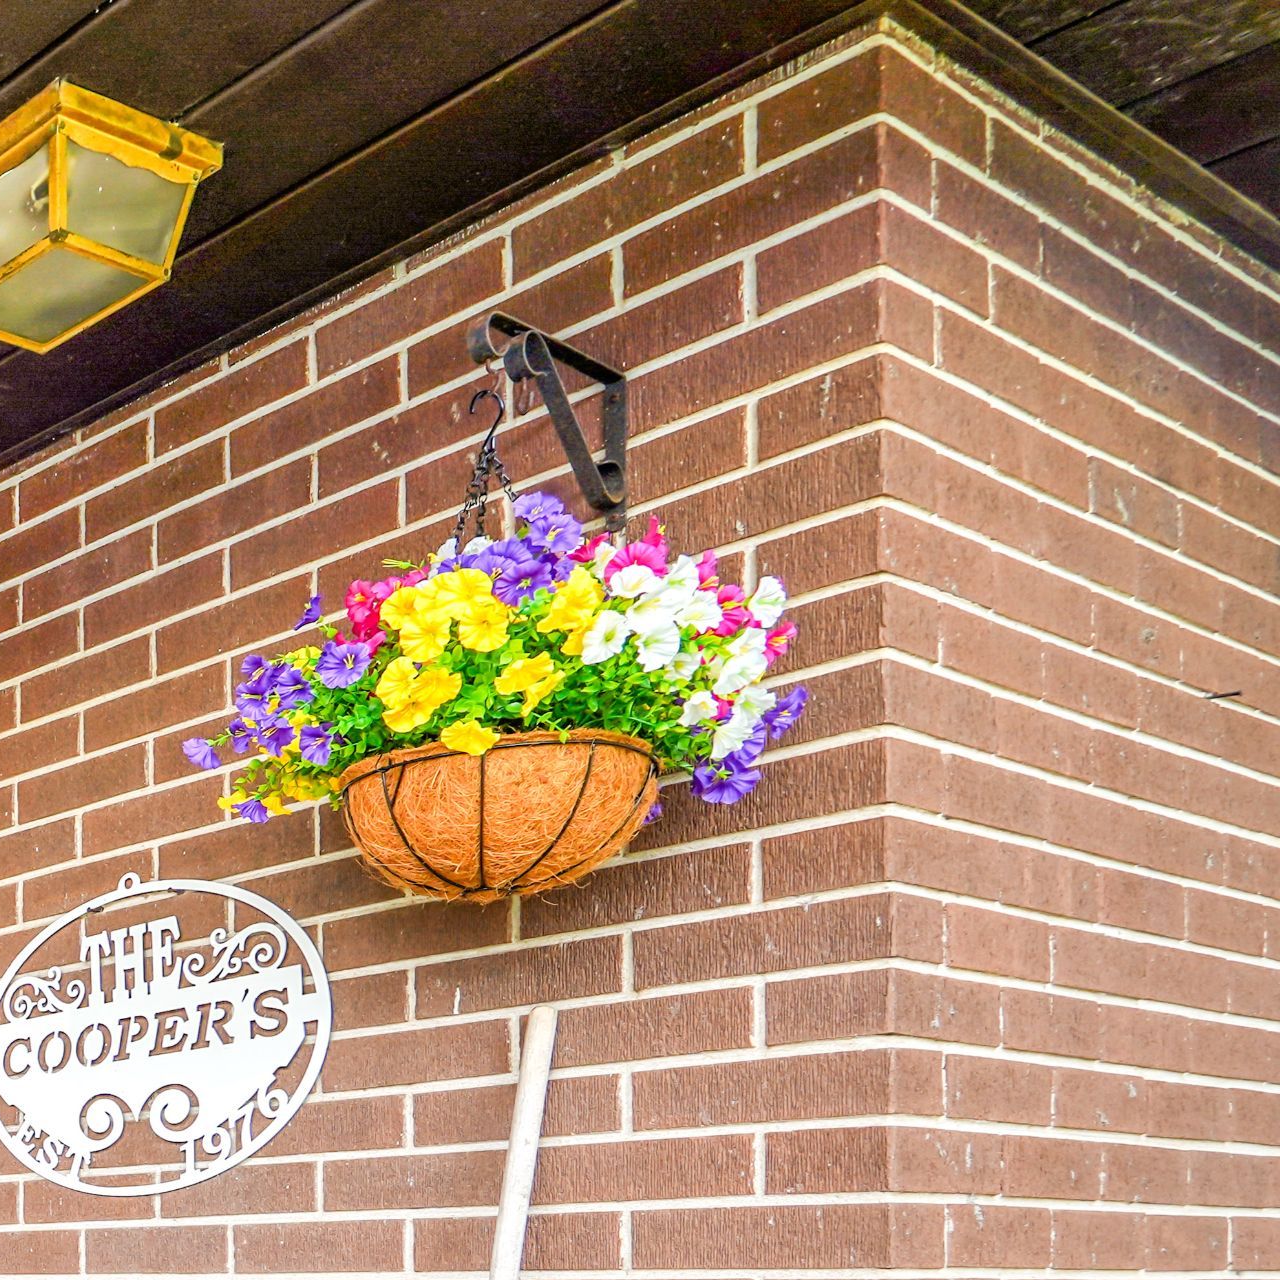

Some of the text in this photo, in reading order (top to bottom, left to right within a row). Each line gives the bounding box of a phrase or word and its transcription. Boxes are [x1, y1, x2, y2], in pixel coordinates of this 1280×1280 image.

[80, 915, 182, 1003] THE
[3, 987, 289, 1080] COOPER'S
[14, 1072, 289, 1181] EST 1976
